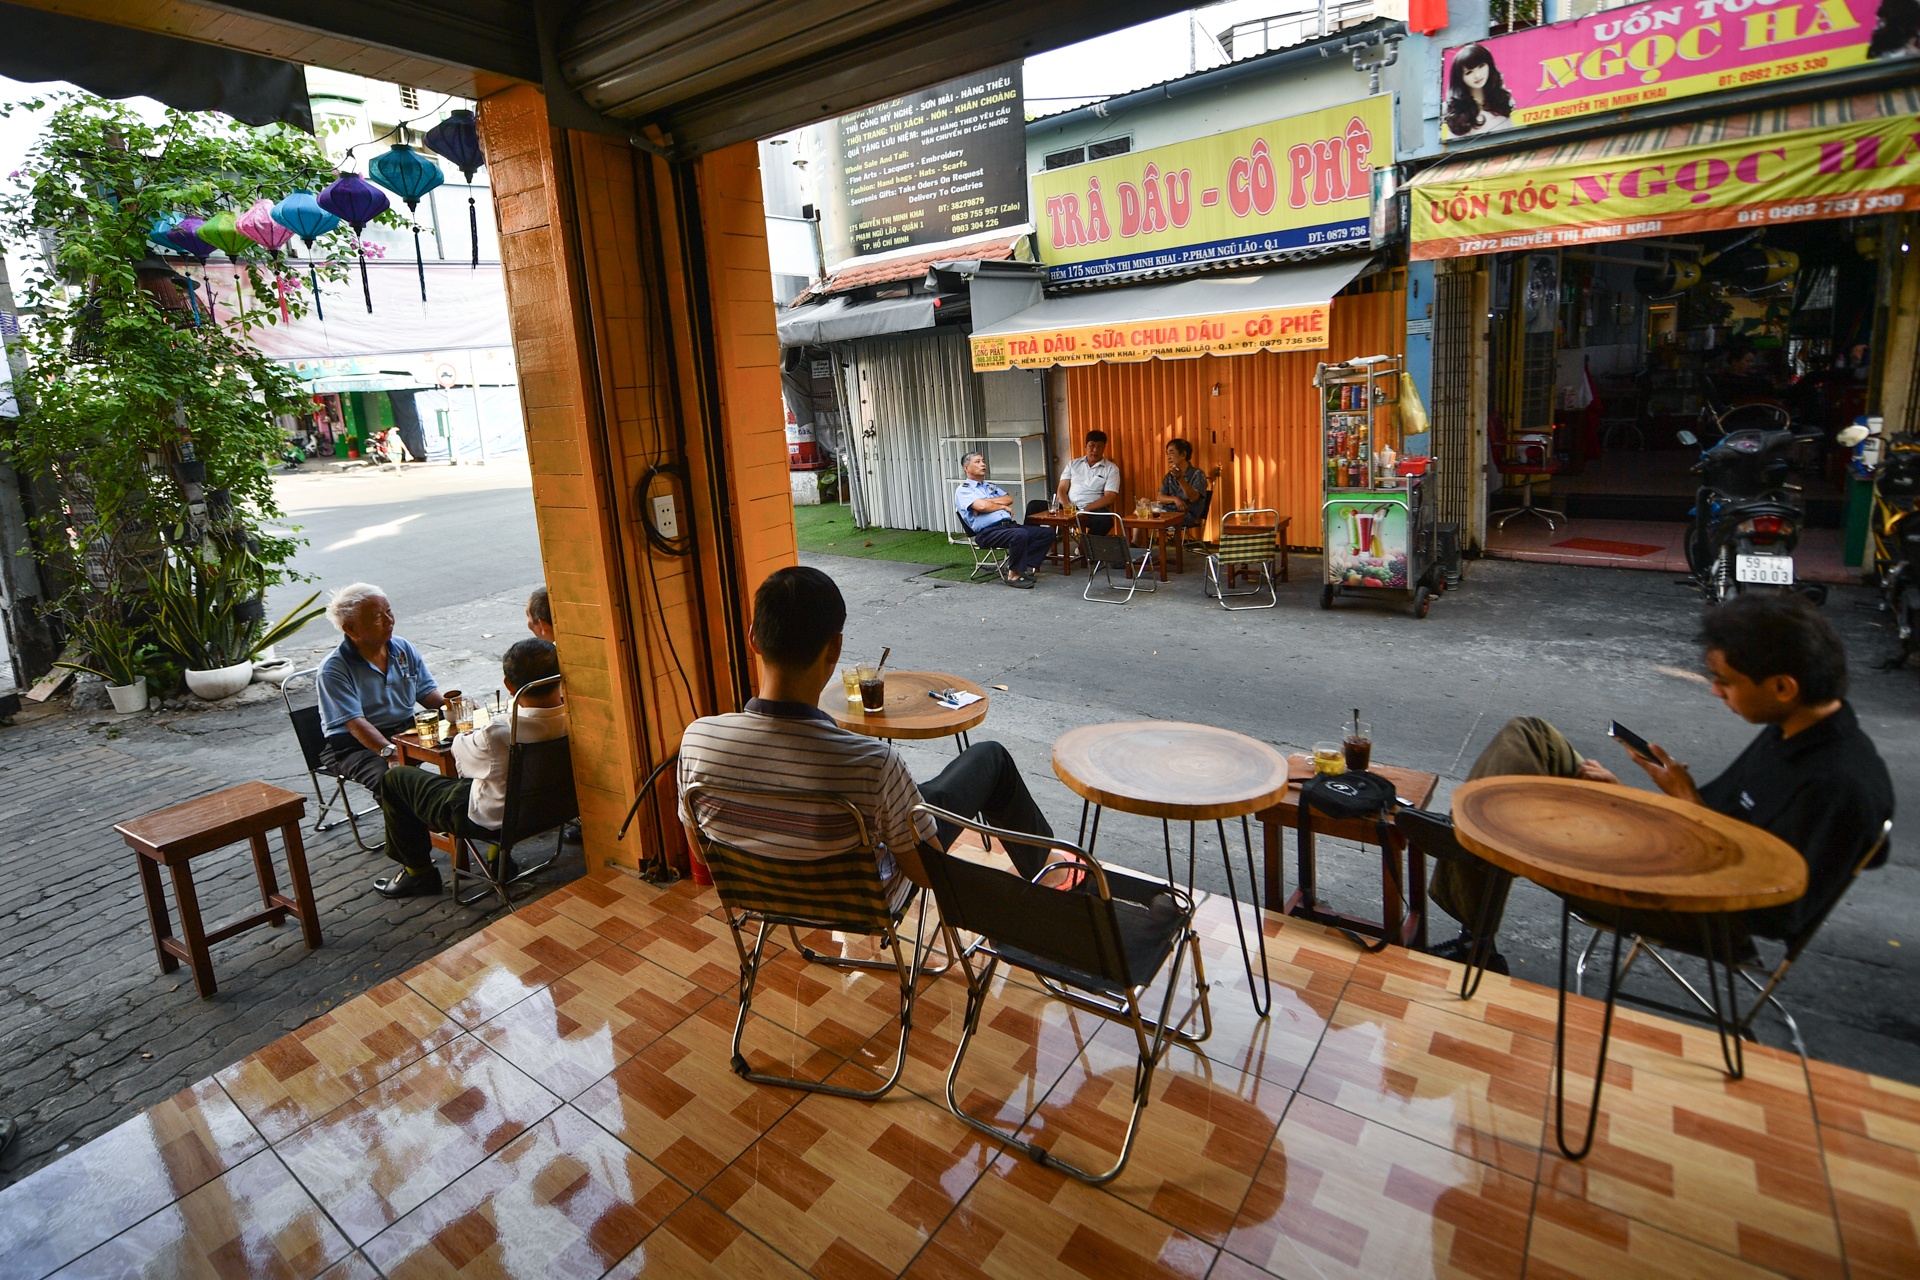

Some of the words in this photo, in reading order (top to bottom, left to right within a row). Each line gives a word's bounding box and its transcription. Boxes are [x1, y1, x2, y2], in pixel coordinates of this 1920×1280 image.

[1594, 6, 1684, 42] UỐN
[1536, 20, 1722, 92] NGỌC
[1718, 74, 1736, 86] ĐT:
[1740, 66, 1772, 83] 0982
[1776, 62, 1799, 76] 755
[1803, 56, 1828, 72] 330
[846, 121, 858, 135] THỦ
[860, 117, 879, 130] CÔNG
[880, 112, 891, 124] MỸ
[894, 104, 913, 120] NGHỆ
[920, 99, 936, 111] SƠN
[938, 94, 953, 106] MÀI
[961, 84, 984, 98] HÀNG
[986, 77, 1010, 92] THÊU
[847, 134, 862, 146] THỜI
[863, 128, 888, 140] TRANG:
[889, 122, 902, 133] TÚI
[904, 115, 924, 129] XÁCH
[930, 108, 947, 120] NÓN
[980, 90, 1016, 106] CHOÀNG
[1523, 108, 1550, 122] 173/2
[1594, 98, 1609, 110] THỊ
[1612, 92, 1639, 106] MINH
[1642, 87, 1666, 100] KHAI
[921, 126, 938, 137] NHẬN
[940, 122, 958, 132] HÀNG
[960, 116, 978, 126] THEO
[980, 111, 994, 120] YÊU
[922, 137, 934, 146] VẬN
[936, 128, 962, 142] CHUYỂN
[973, 122, 987, 132] CÁC
[848, 146, 860, 158] QUÀ
[862, 142, 880, 154] TẶNG
[898, 130, 918, 142] NIỆM:
[844, 164, 862, 174] Whole
[864, 160, 878, 168] Sale
[880, 154, 892, 164] And
[894, 150, 909, 160] Tail:
[850, 176, 862, 184] Fine
[864, 170, 878, 180] Arts
[884, 162, 914, 176] Lacquers
[921, 149, 964, 165] Embroidery
[850, 184, 876, 196] Fashion:
[877, 177, 894, 188] Hand
[896, 174, 912, 184] bags
[919, 168, 936, 178] Hats
[942, 160, 968, 172] Scarfs
[851, 193, 878, 206] Souvenis
[879, 189, 896, 199] Gifts:
[898, 184, 916, 194] Take
[918, 179, 938, 190] Oders
[940, 176, 950, 184] On
[952, 168, 984, 182] Request
[1046, 176, 1112, 250] TRÀ
[1117, 162, 1192, 238] DÂU
[1227, 137, 1278, 218] CÔ
[1288, 116, 1373, 210] PHÊ
[1431, 185, 1490, 224] UỐN
[1499, 180, 1559, 215] TÓC
[1567, 147, 1786, 206] NGỌC
[908, 192, 938, 204] Delivery
[939, 188, 948, 196] To
[950, 181, 983, 194] Coutries
[938, 204, 950, 212] ĐT:
[950, 196, 984, 210] 38279879
[849, 224, 858, 232] 175
[882, 216, 892, 225] THỊ
[892, 212, 908, 222] MINH
[910, 209, 924, 219] KHAI
[952, 212, 968, 222] 0839
[970, 208, 983, 218] 755
[984, 206, 998, 216] 957
[1000, 202, 1020, 213] (Zalo)
[1737, 210, 1764, 223] ĐT:
[1769, 202, 1816, 220] 0982
[1823, 197, 1860, 214] 755
[1864, 194, 1904, 209] 330
[856, 232, 871, 242] PHẠM
[872, 228, 884, 238] NGŨ
[885, 226, 896, 235] LÃO
[902, 222, 918, 232] QUẬN
[952, 224, 969, 234] 0903
[970, 220, 984, 230] 304
[986, 218, 999, 228] 226
[1308, 232, 1325, 243] ĐT:
[1326, 228, 1348, 240] 0879
[1350, 226, 1366, 237] 736
[1459, 238, 1498, 252] 173/2
[1556, 228, 1578, 242] THỊ
[1582, 224, 1622, 238] MINH
[1626, 220, 1662, 234] KHAI
[882, 237, 892, 246] CHÍ
[894, 236, 910, 244] MINH
[1068, 265, 1084, 278] 175
[1085, 260, 1116, 276] NGUYỄN
[1117, 261, 1132, 272] THỊ
[1132, 258, 1154, 268] MINH
[1156, 254, 1176, 266] KHAI
[1182, 248, 1216, 261] P.PHẠM
[1218, 242, 1237, 256] NGŨ
[1239, 240, 1258, 253] LÃO
[1264, 239, 1278, 251] Q.1
[1008, 336, 1039, 356] TRÀ
[1044, 334, 1076, 354] DÂU
[1092, 329, 1126, 350] SỮA
[1130, 327, 1180, 346] CHUA
[1186, 320, 1226, 342] DÂU
[1245, 314, 1274, 337] CÔ
[1280, 310, 1324, 334] PHÊ
[1142, 347, 1172, 356] P.PHẠM
[1176, 344, 1192, 353] NGŨ
[1194, 342, 1210, 352] LÃO
[1260, 339, 1282, 347] 0879
[1742, 570, 1788, 582] 130.03
[1746, 557, 1784, 570] 59-T2
